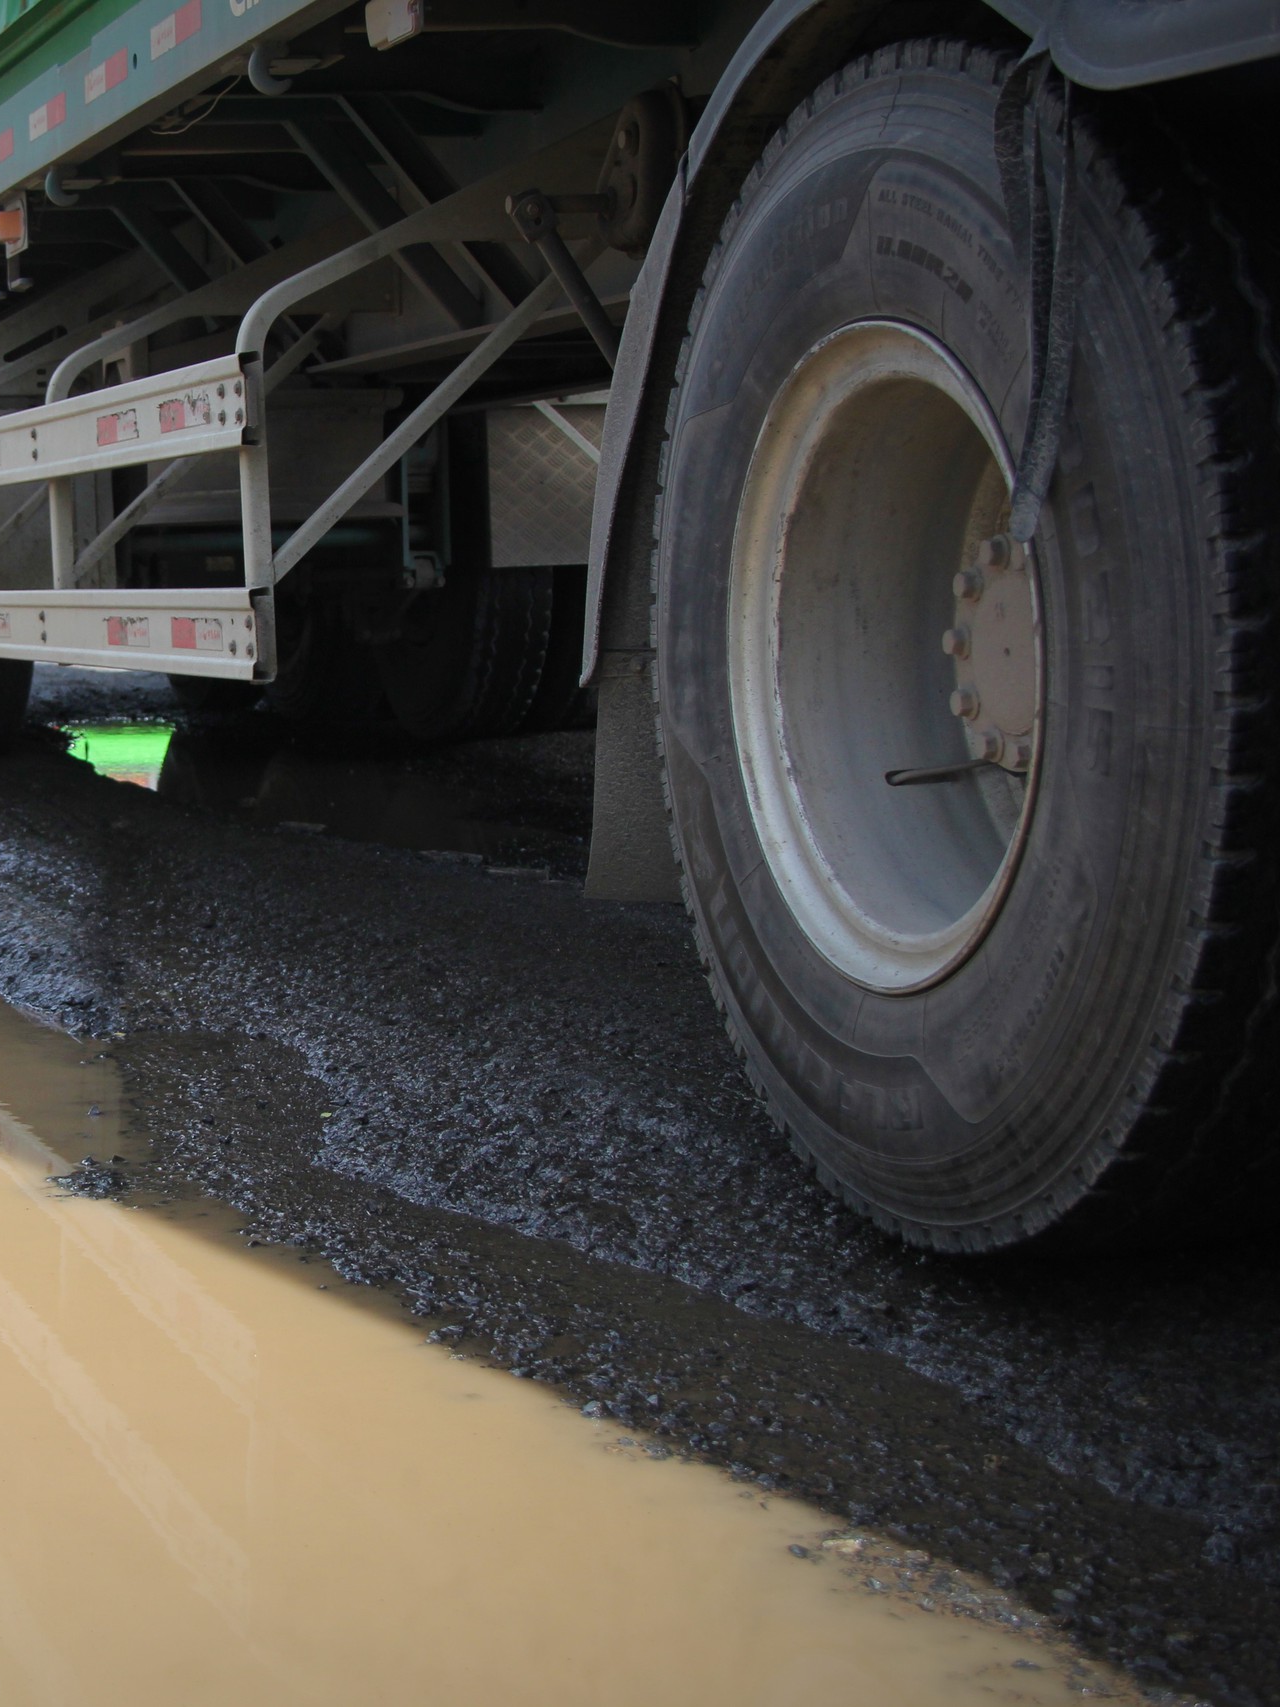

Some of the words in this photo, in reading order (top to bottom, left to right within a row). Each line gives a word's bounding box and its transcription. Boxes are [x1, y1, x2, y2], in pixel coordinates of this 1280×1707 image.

[877, 188, 897, 204] ALL
[901, 192, 933, 217] STEEL
[935, 208, 974, 248] RADIAL
